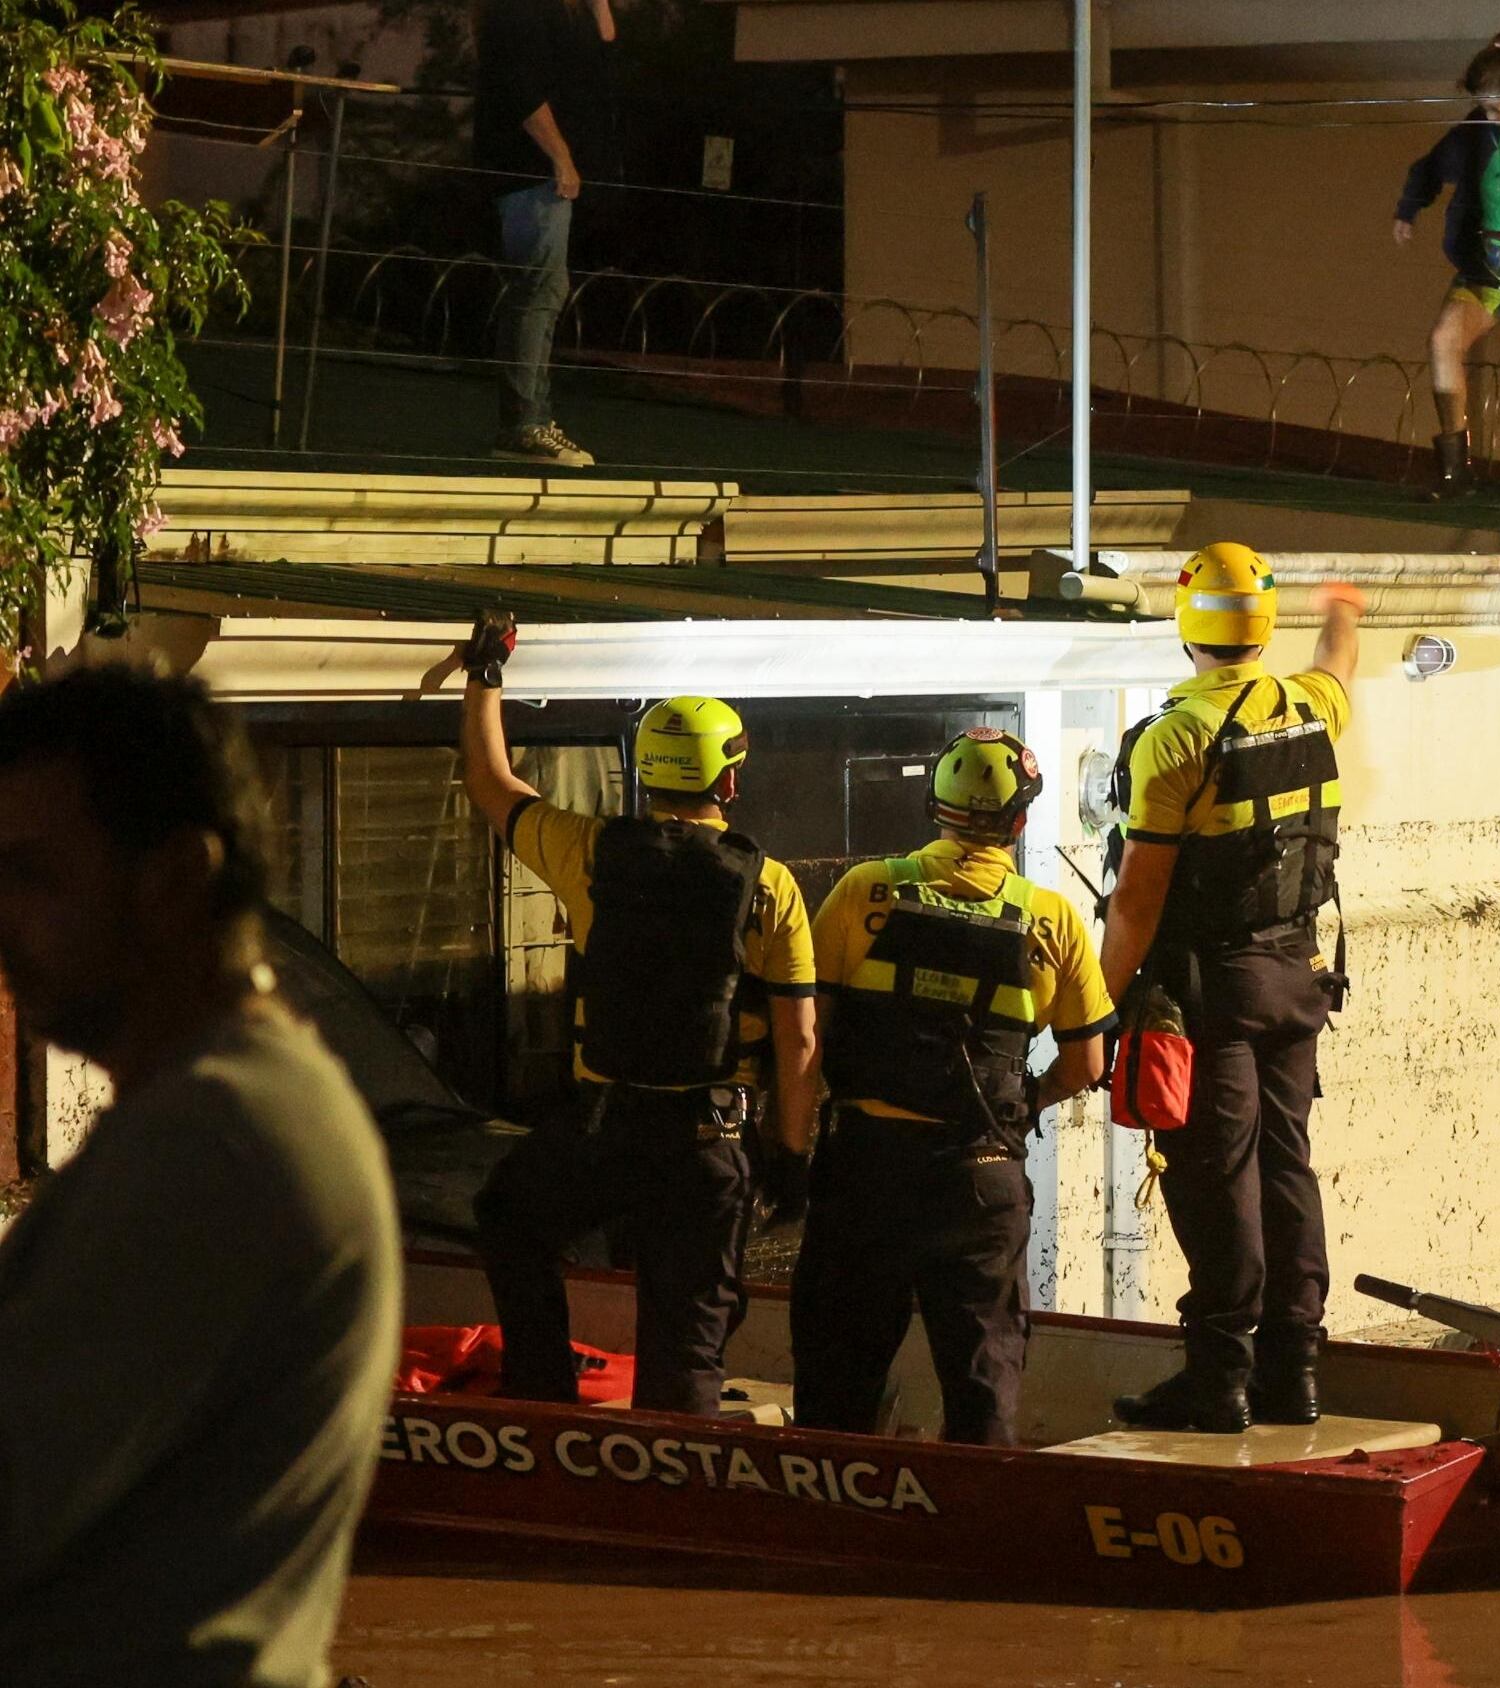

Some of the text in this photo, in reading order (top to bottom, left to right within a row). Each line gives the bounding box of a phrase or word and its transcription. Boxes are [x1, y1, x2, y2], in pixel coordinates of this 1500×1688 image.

[554, 1430, 770, 1490] COSTA
[779, 1454, 939, 1514] RICA
[1084, 1504, 1245, 1569] E-06
